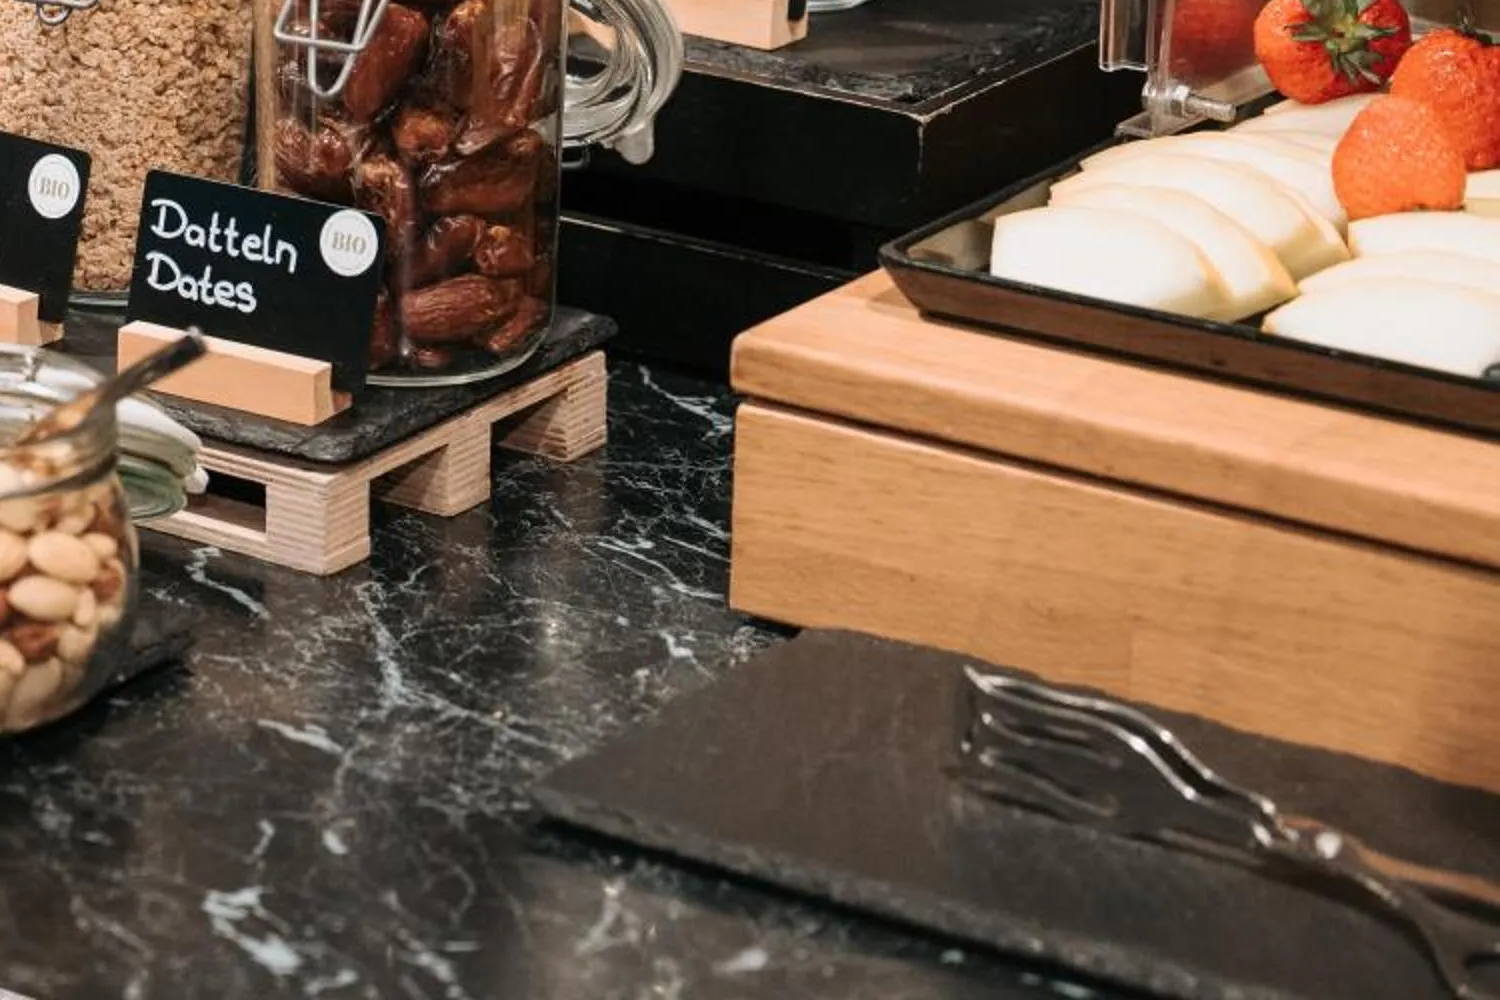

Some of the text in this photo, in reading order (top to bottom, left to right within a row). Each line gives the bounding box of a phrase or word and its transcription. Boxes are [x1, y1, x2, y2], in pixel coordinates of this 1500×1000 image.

[38, 176, 69, 200] BIO
[150, 199, 298, 275] Datteln
[331, 230, 367, 255] BIO
[145, 251, 257, 313] Dates
